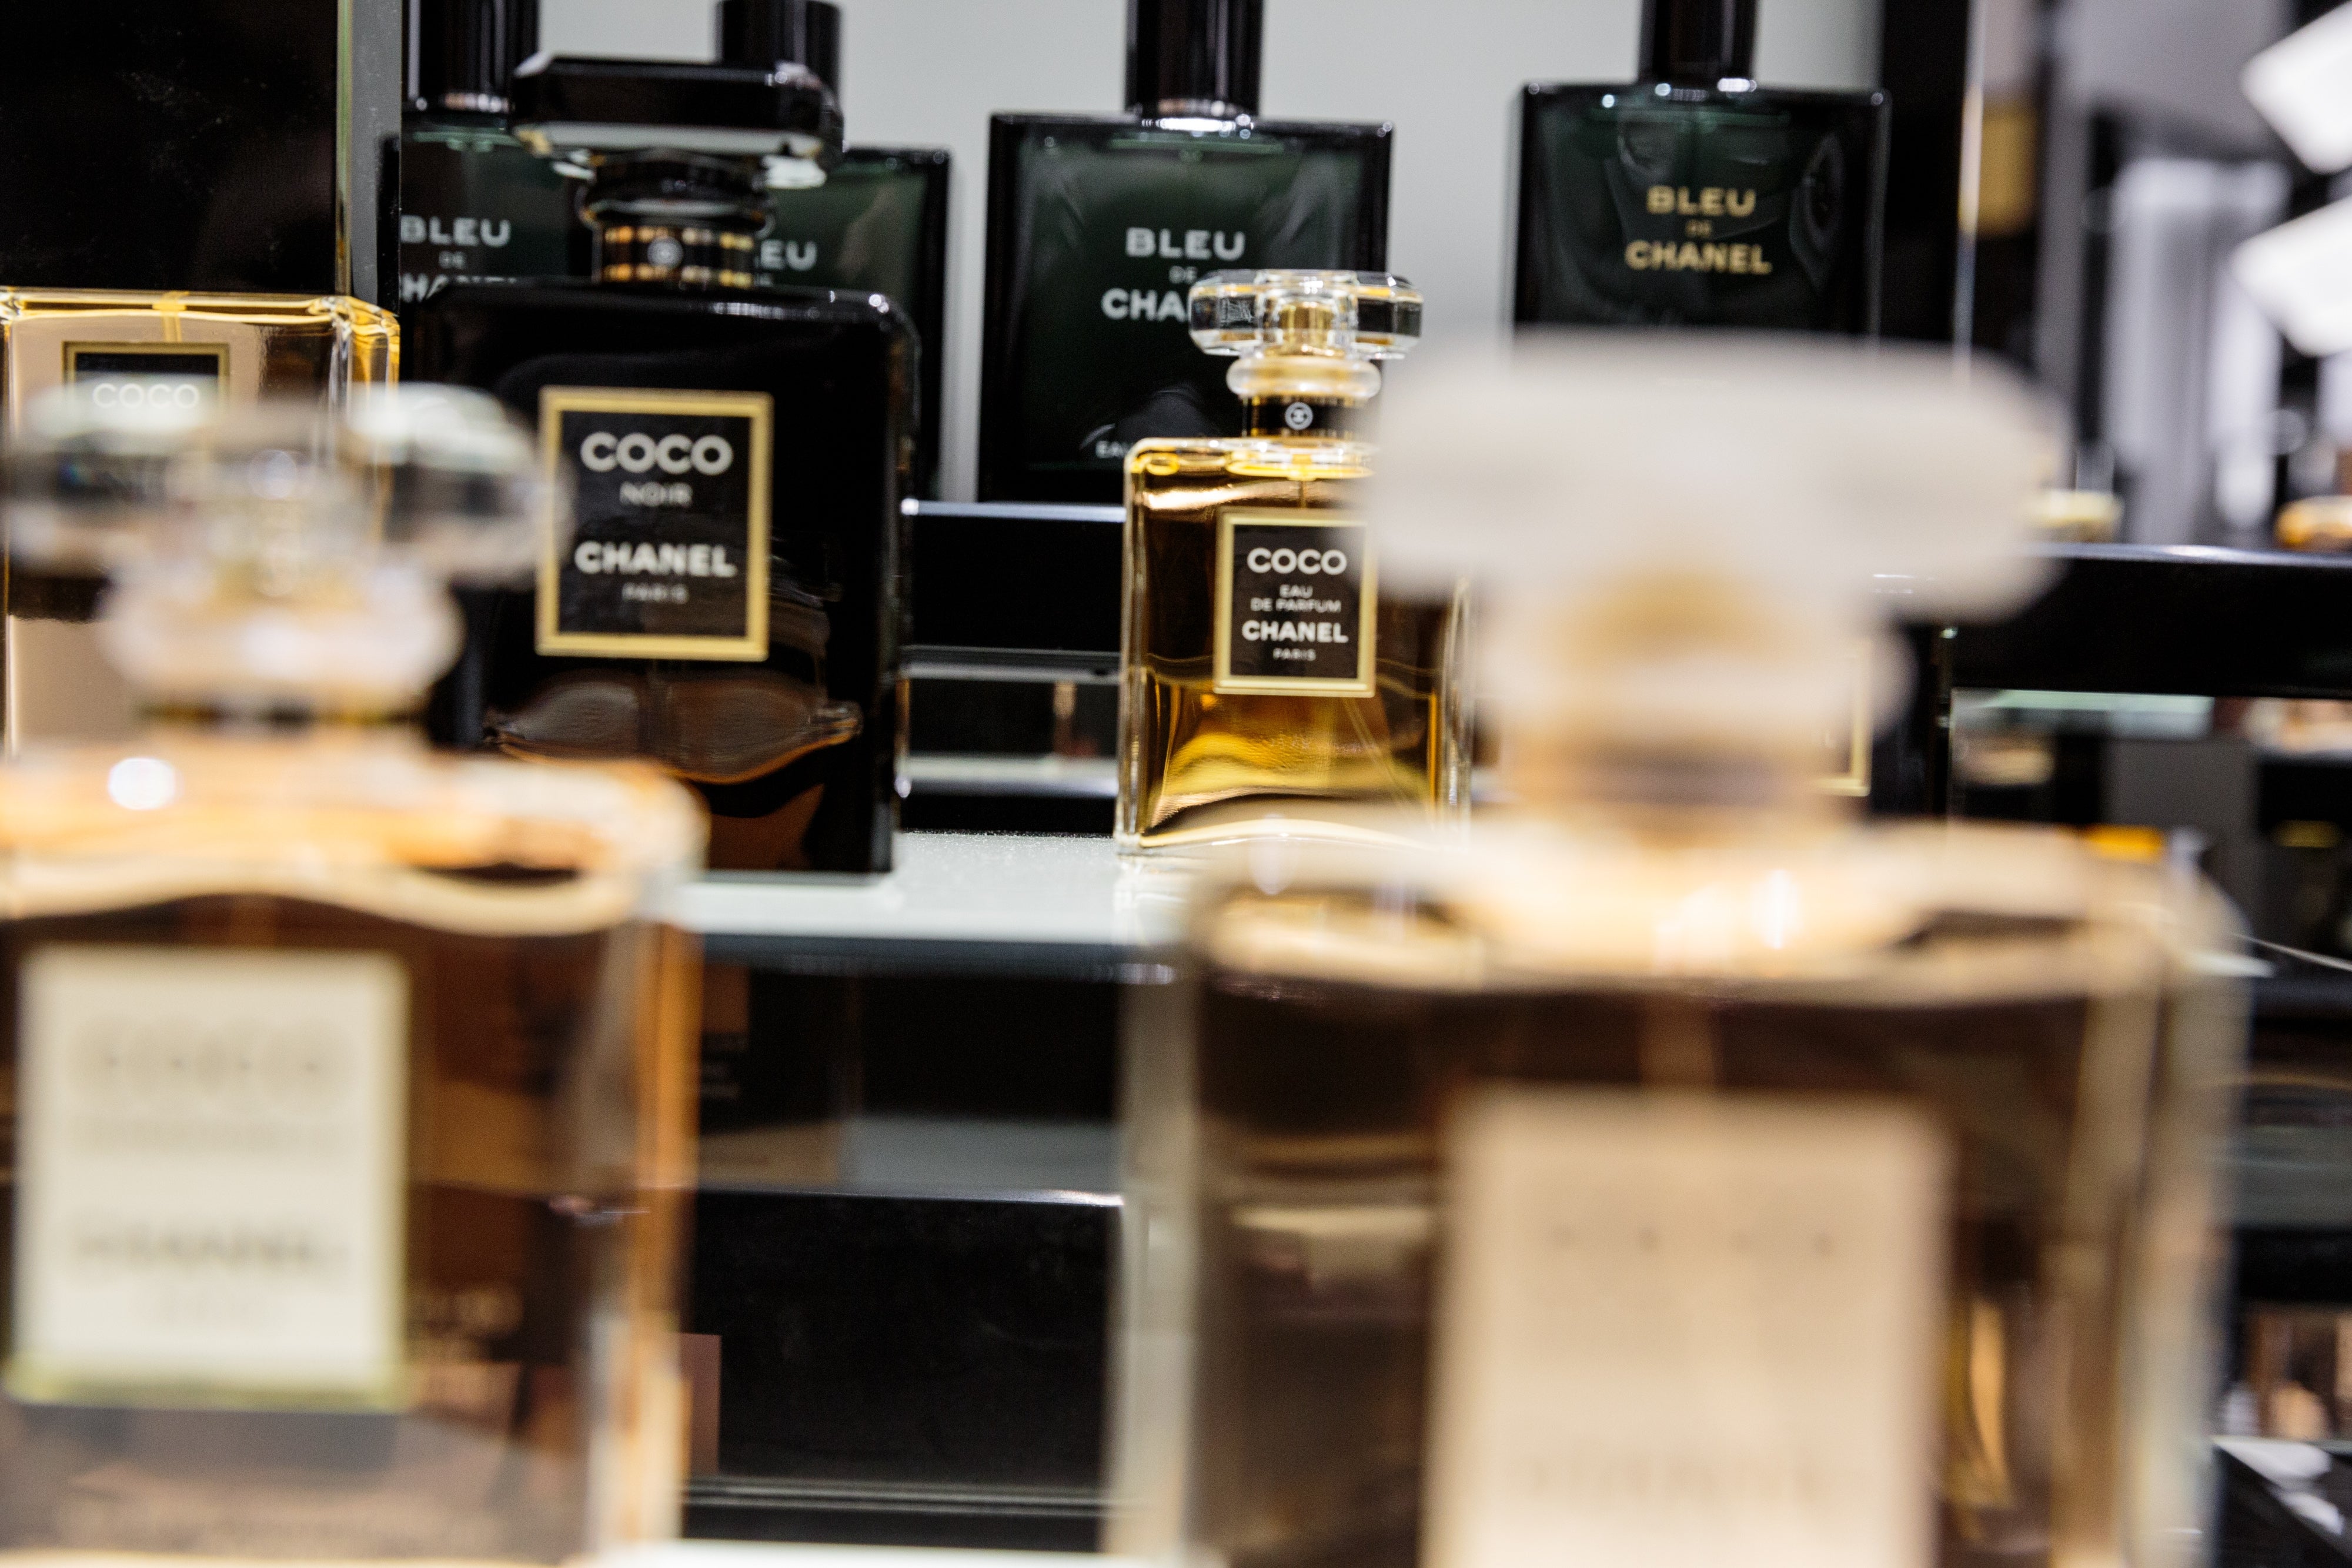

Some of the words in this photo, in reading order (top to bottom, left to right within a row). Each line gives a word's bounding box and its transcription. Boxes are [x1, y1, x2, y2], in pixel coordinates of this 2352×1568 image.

[1647, 185, 1757, 218] BLEU
[400, 214, 511, 248] BLEU
[1125, 227, 1246, 262] BLEU
[755, 239, 818, 272] EU
[1625, 239, 1773, 275] CHANEL
[1101, 287, 1187, 323] CHA
[92, 383, 200, 410] COCO
[580, 432, 734, 476] COCO
[619, 482, 692, 507] NOIR
[574, 541, 738, 578] CHANEL
[1247, 547, 1348, 575] COCO
[1250, 597, 1273, 611] DE
[1275, 599, 1342, 613] PARFUM
[1279, 584, 1313, 599] EAU
[1241, 620, 1349, 643] CHANEL
[1272, 648, 1317, 661] PARIS
